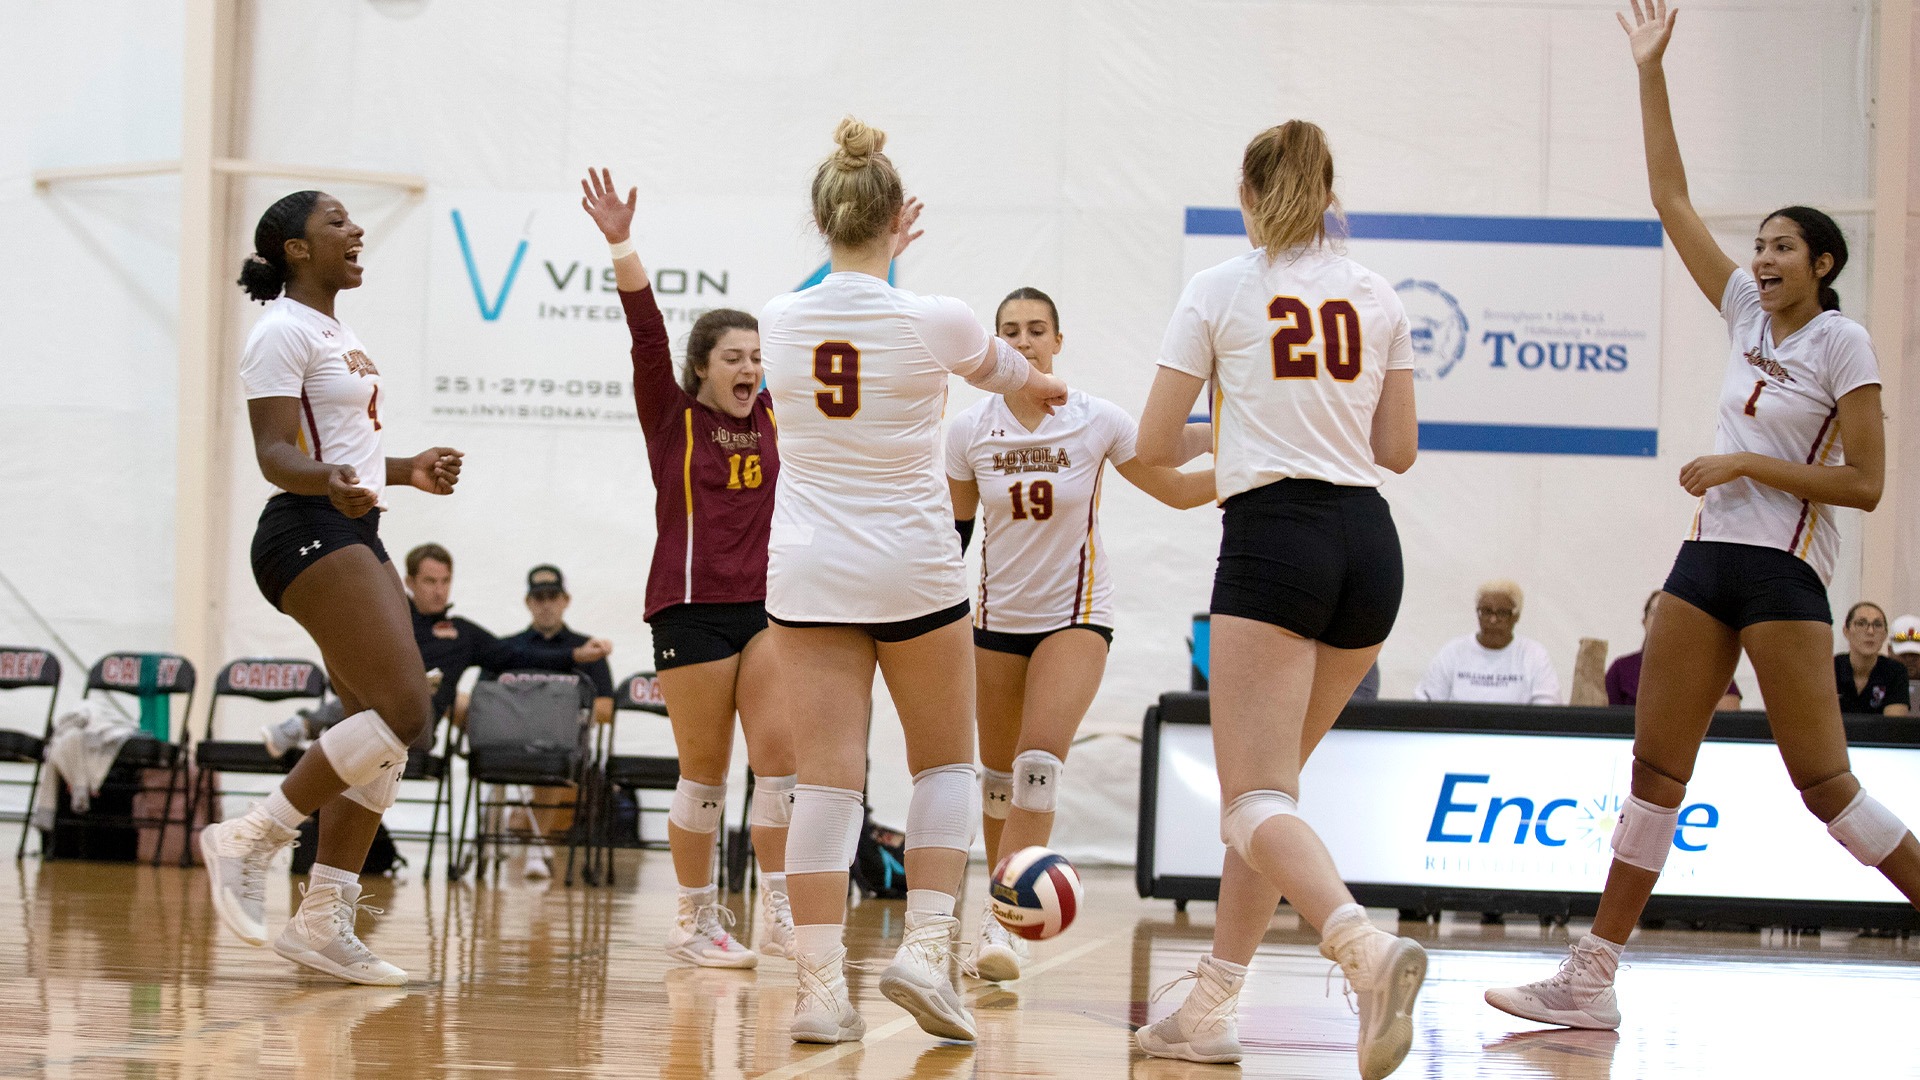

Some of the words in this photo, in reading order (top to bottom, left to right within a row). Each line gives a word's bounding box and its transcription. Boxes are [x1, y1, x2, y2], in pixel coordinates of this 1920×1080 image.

[545, 261, 728, 295] VISON
[1267, 294, 1363, 384] 20
[1482, 329, 1629, 373] TOURS
[812, 340, 861, 420] 9
[1744, 379, 1767, 418] 1
[726, 453, 763, 490] 16
[993, 447, 1072, 471] LOYOLA
[1008, 479, 1054, 521] 19
[228, 662, 313, 691] CAREY
